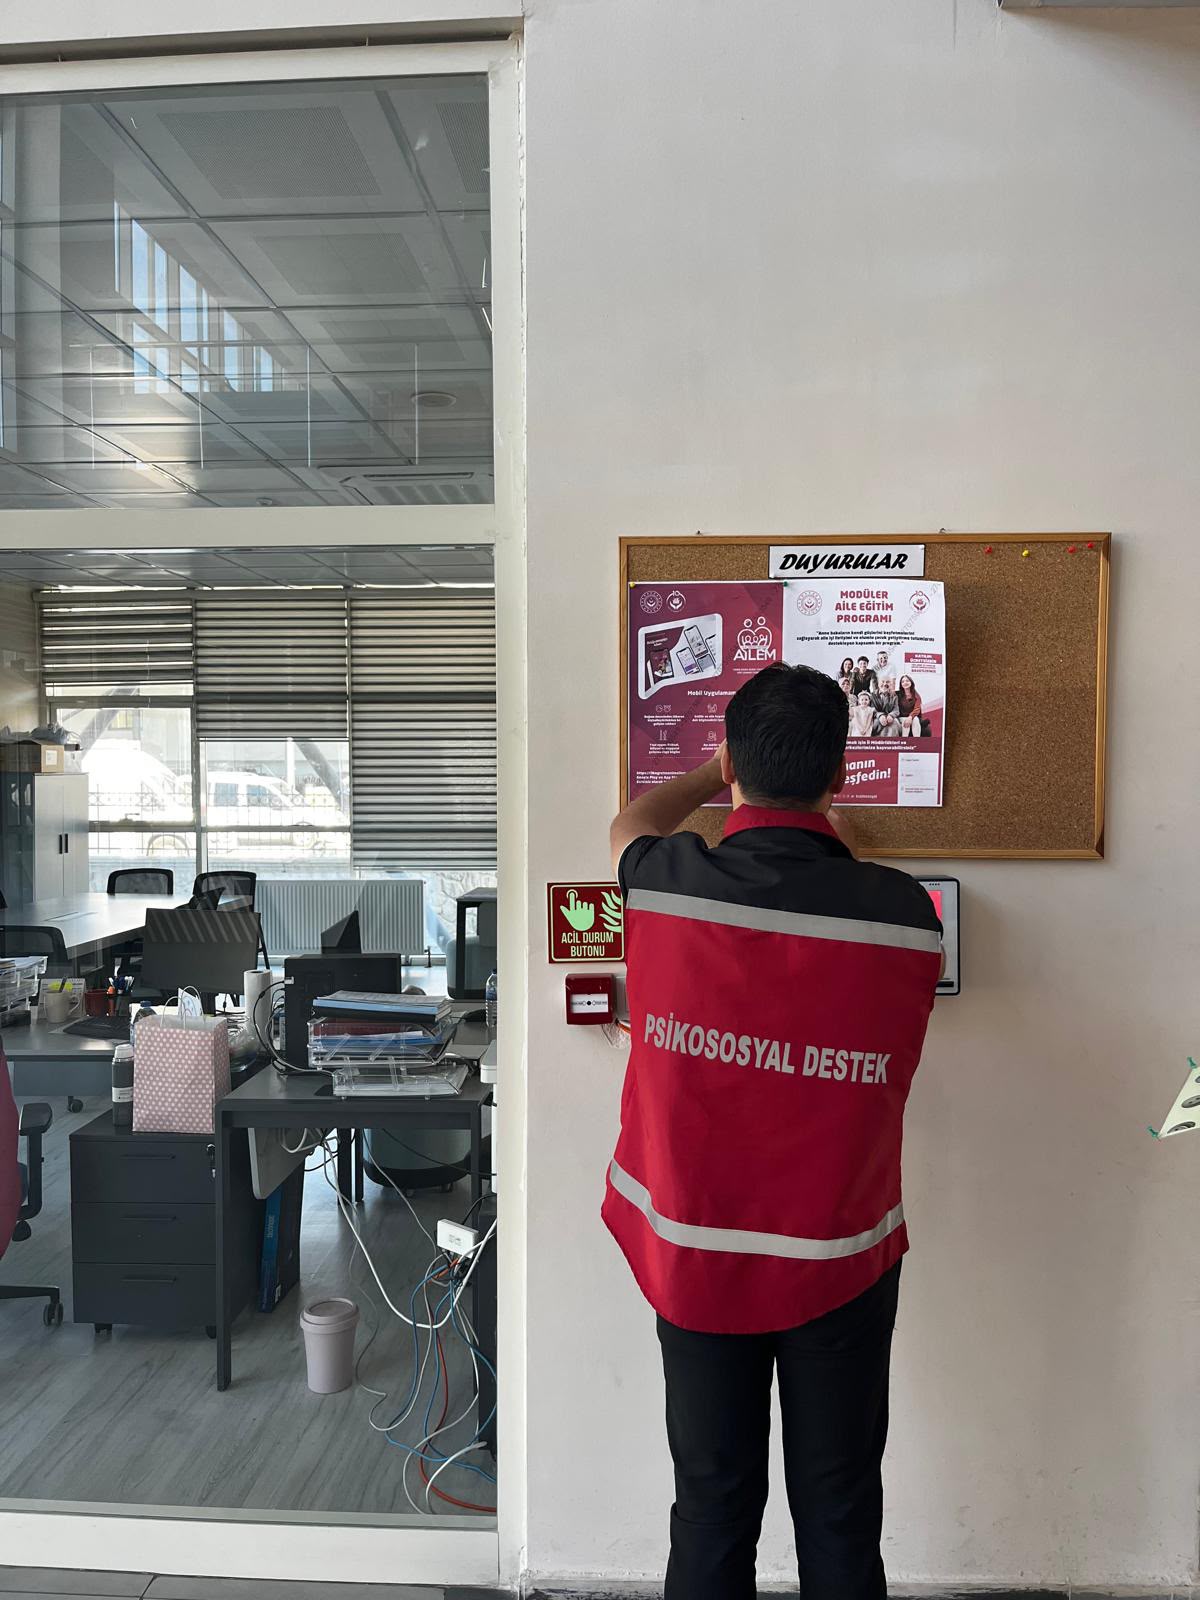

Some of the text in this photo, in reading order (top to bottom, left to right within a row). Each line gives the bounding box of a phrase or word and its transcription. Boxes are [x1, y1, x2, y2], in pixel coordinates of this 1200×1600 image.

[779, 553, 908, 573] DUYURULAR
[840, 588, 889, 599] MODÜLER
[835, 600, 894, 611] AİLE EĞİTİM
[836, 614, 892, 623] PROGRAMI
[845, 767, 892, 786] eşfedin!
[561, 930, 614, 944] ACİL DURUM
[570, 945, 605, 957] BUTONU
[643, 1012, 892, 1084] PSİKOSOSYAL DESTEK
